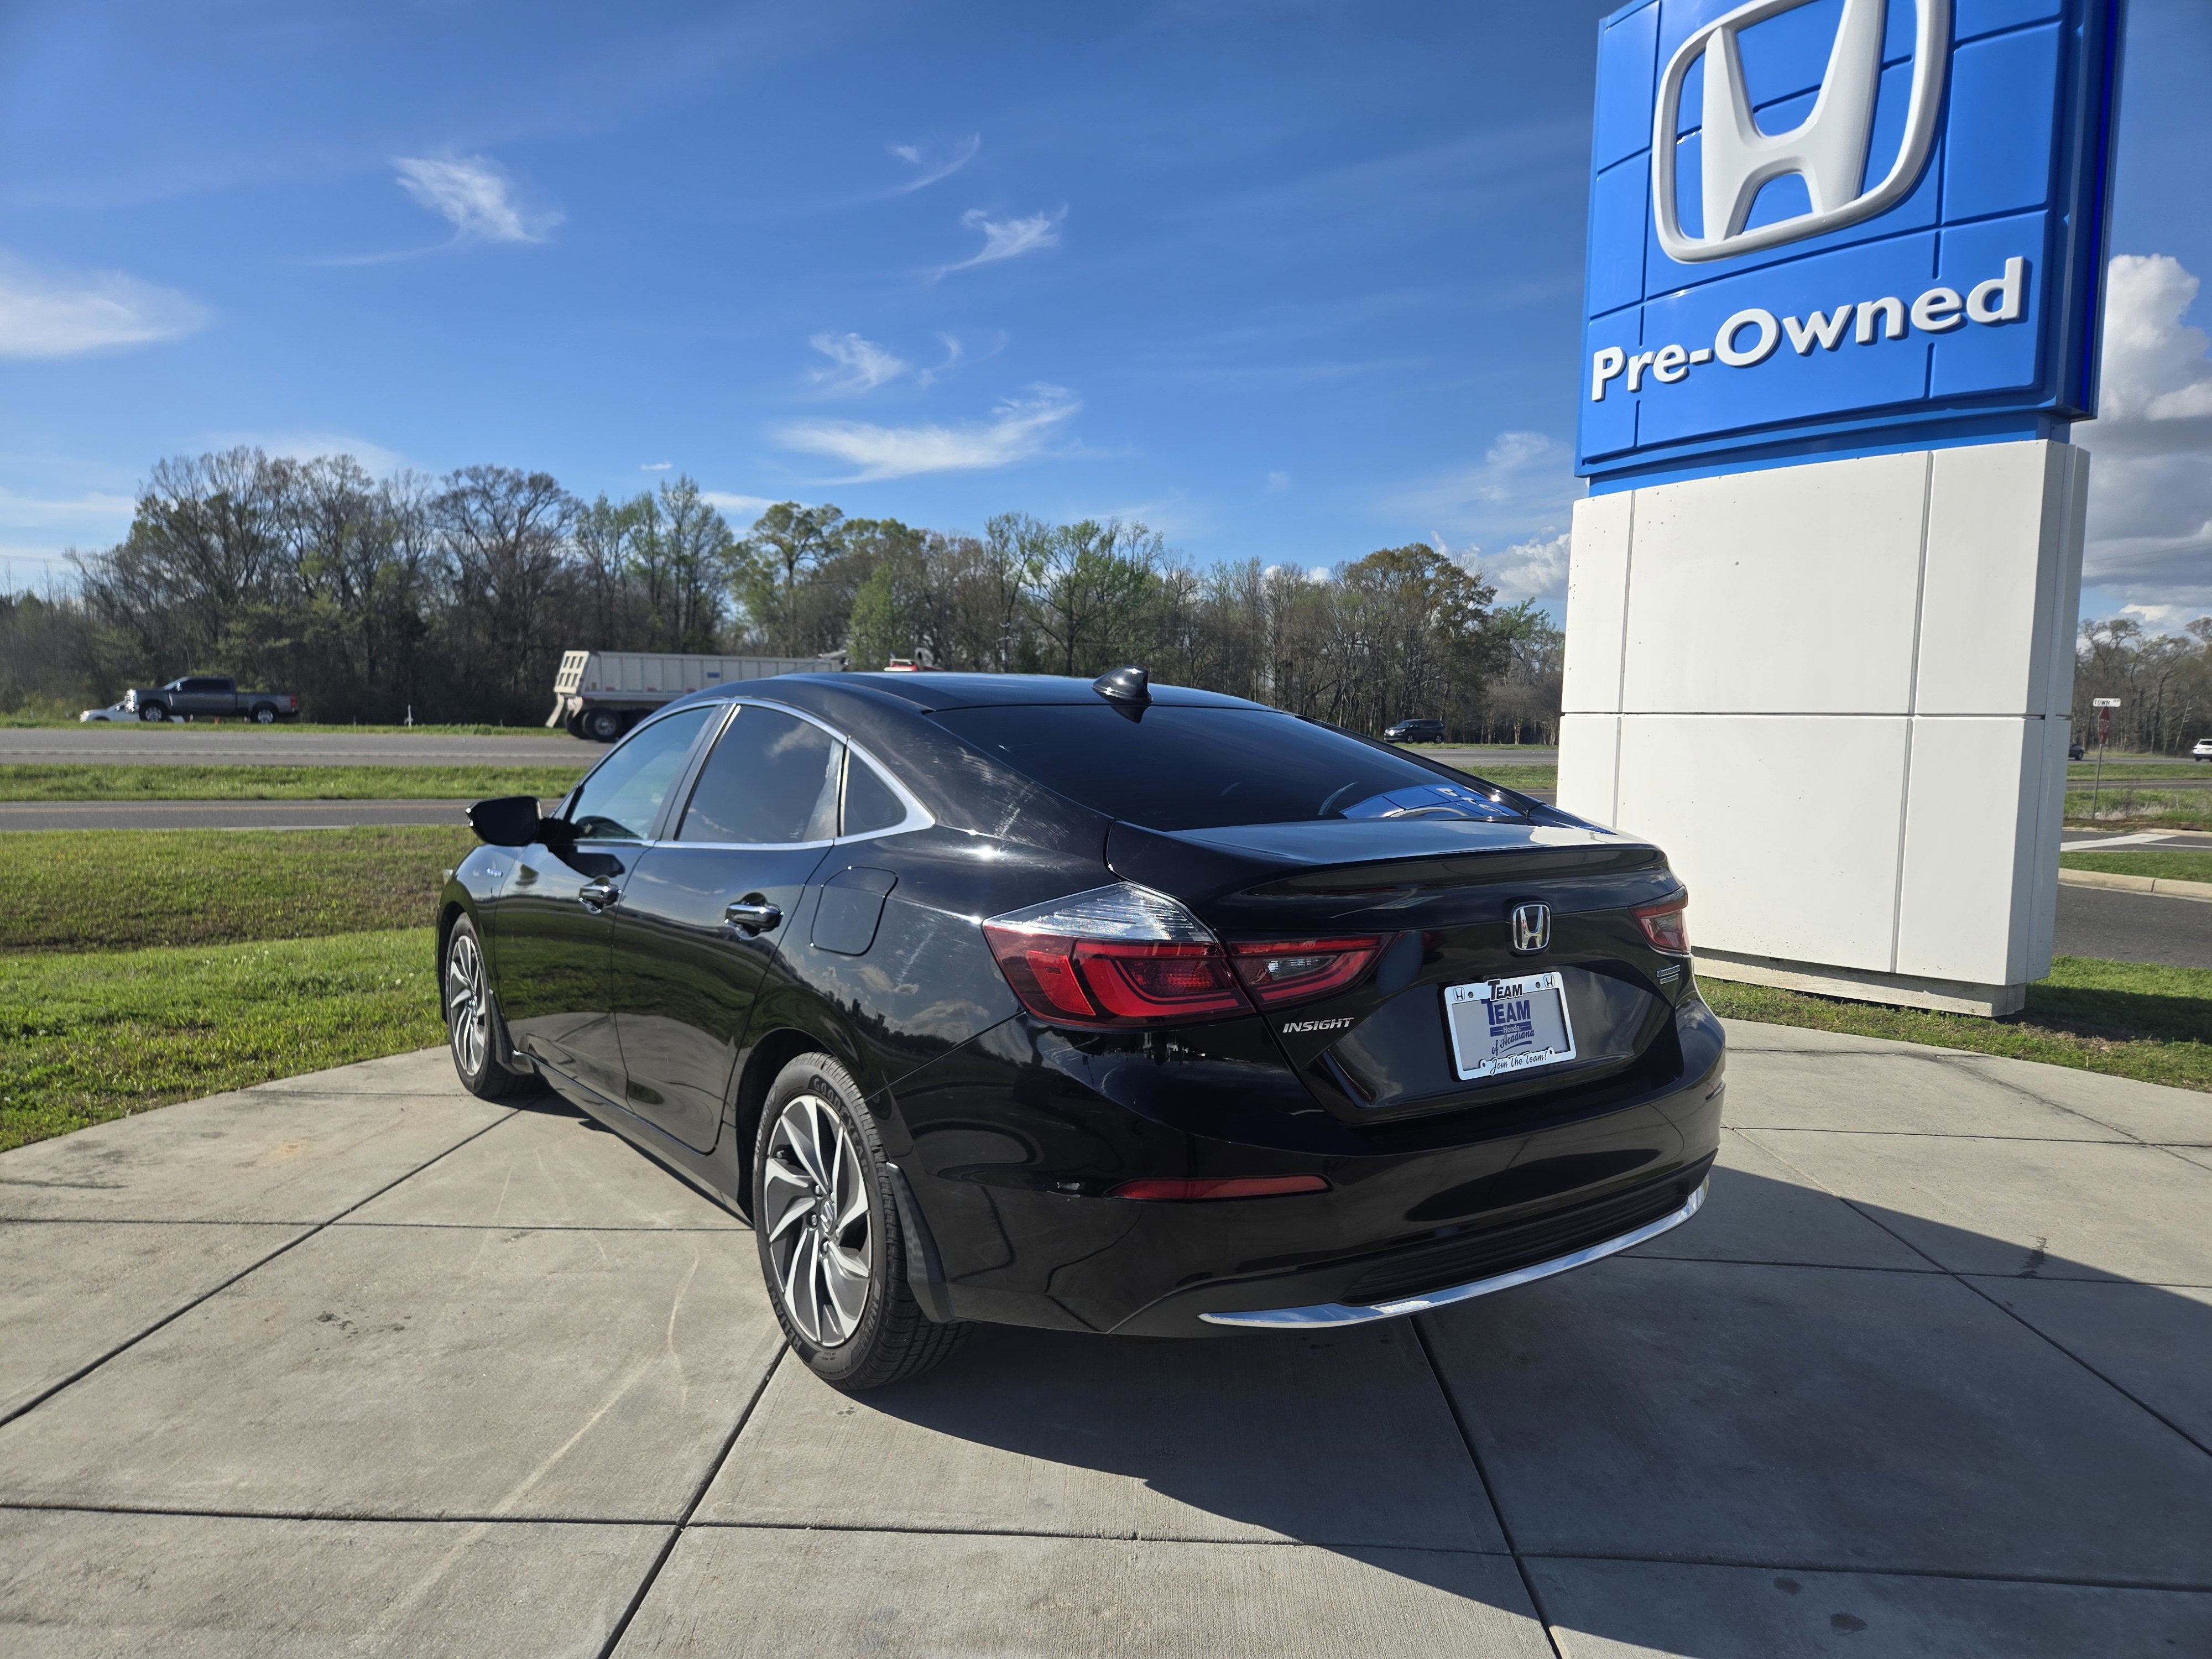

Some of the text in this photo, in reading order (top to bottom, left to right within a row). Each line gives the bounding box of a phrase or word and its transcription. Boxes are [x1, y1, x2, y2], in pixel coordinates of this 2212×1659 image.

[1592, 256, 2025, 402] Pre-Owned
[1488, 980, 1522, 999] TEAM
[1481, 999, 1531, 1025] TEAM
[1283, 1018, 1354, 1033] INSIGHT
[1503, 1025, 1520, 1034] Honda
[1492, 1029, 1535, 1056] of Acadiana
[1490, 1051, 1547, 1074] Join The Team!
[813, 1077, 869, 1173] GOODYEAR
